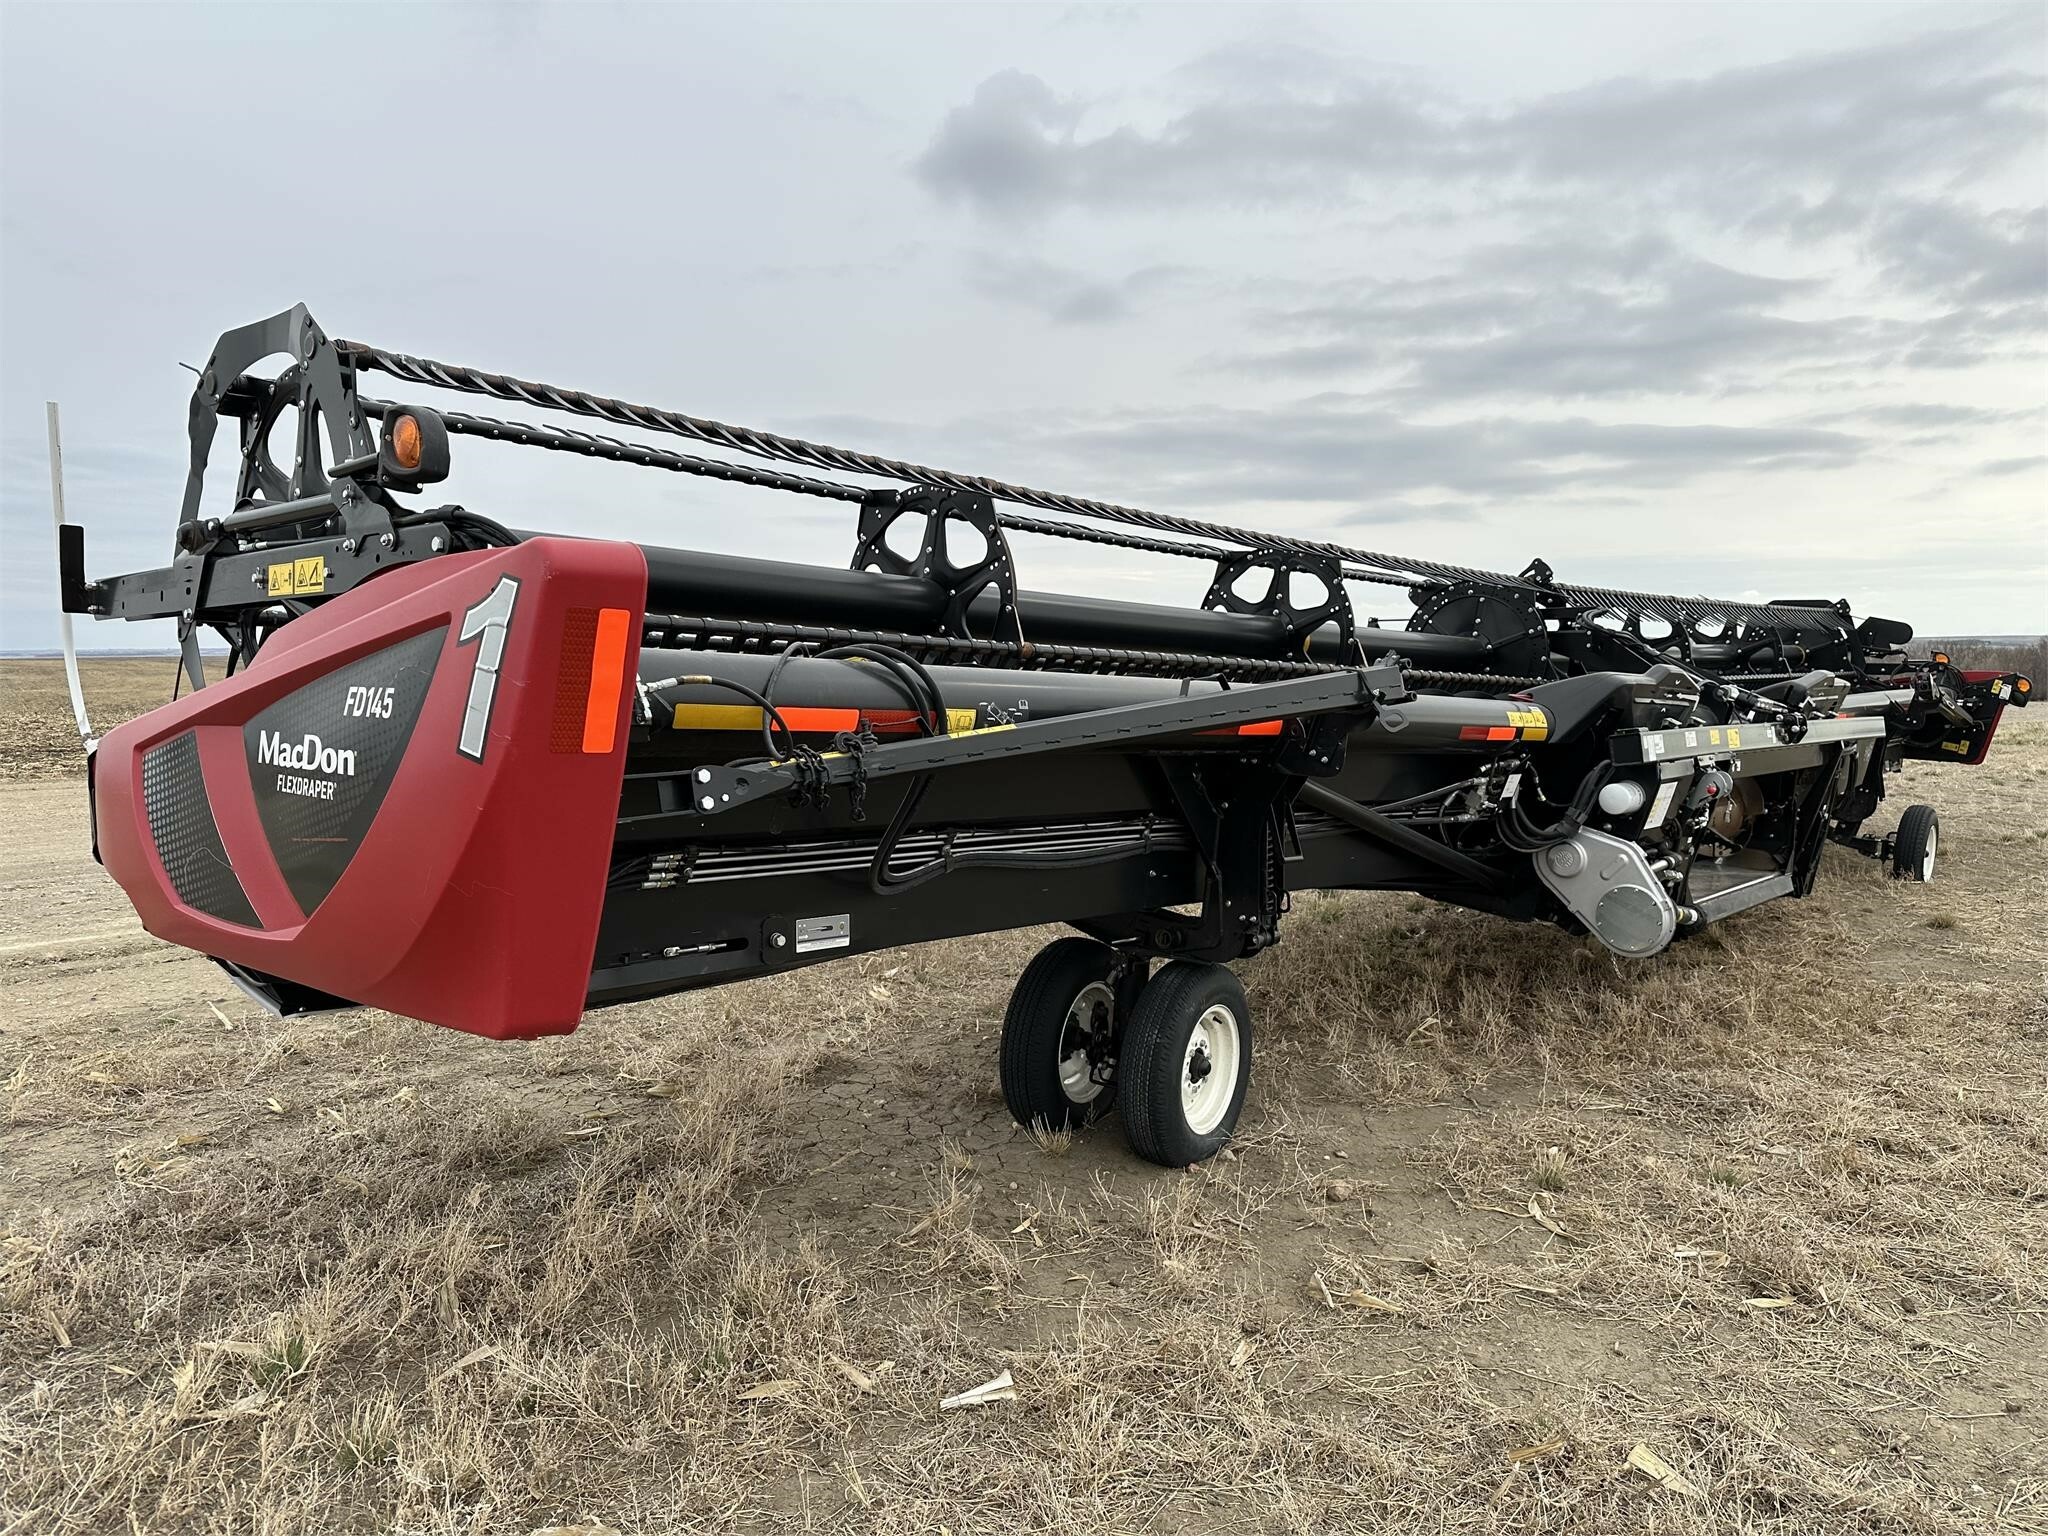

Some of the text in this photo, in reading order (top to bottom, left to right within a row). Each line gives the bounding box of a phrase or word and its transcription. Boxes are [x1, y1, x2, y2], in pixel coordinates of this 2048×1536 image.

[457, 574, 520, 763] 1
[343, 686, 395, 719] FD145
[257, 729, 356, 776] MacDon
[276, 774, 335, 800] FLEXDRAPER
